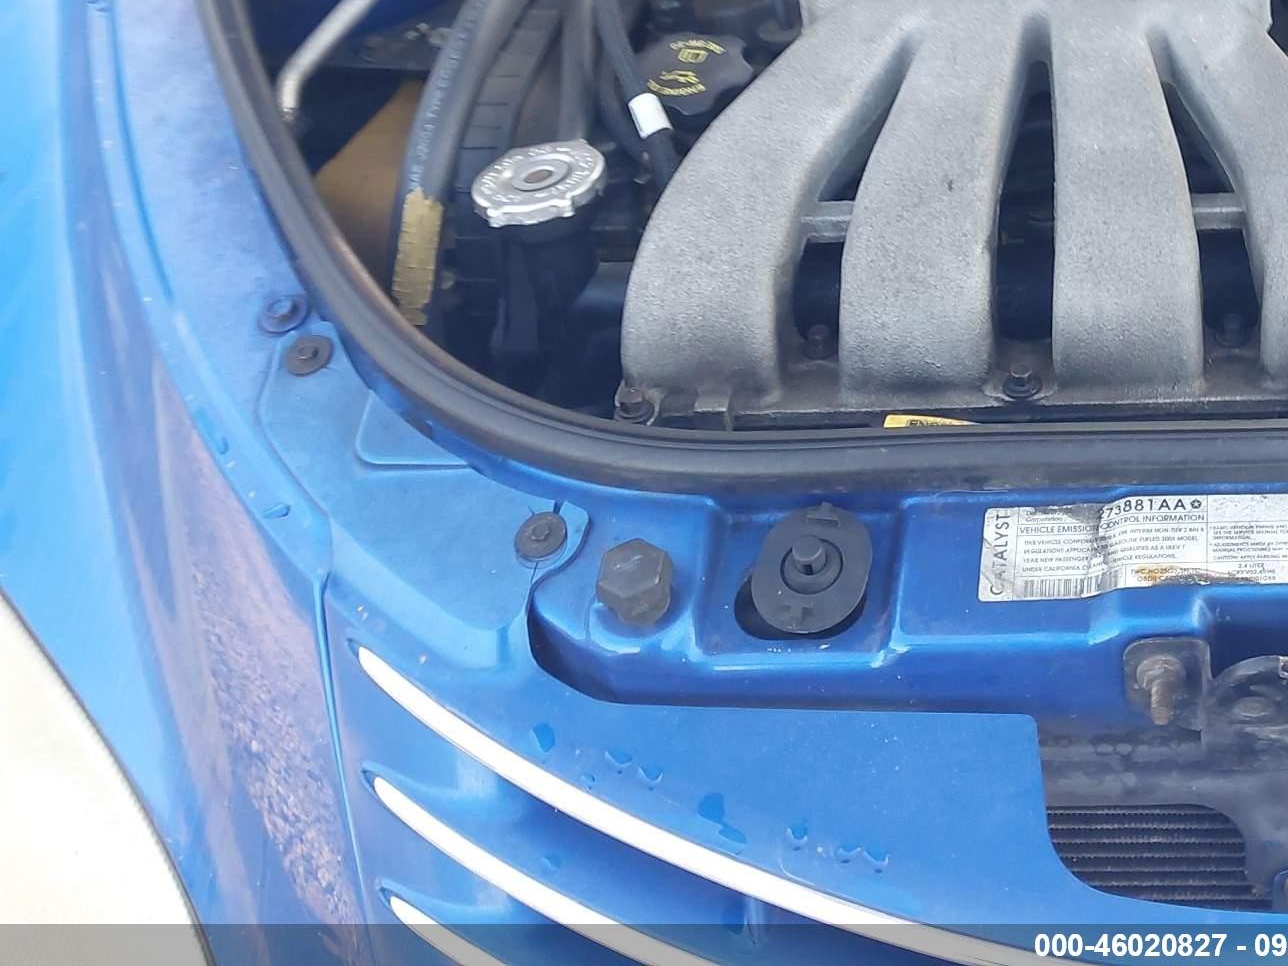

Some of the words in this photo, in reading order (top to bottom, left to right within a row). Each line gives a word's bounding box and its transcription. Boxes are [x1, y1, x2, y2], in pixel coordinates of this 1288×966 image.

[1020, 526, 1055, 534] VEHICLE
[1100, 514, 1140, 530] CONTROL
[1142, 514, 1205, 523] INFORMATION
